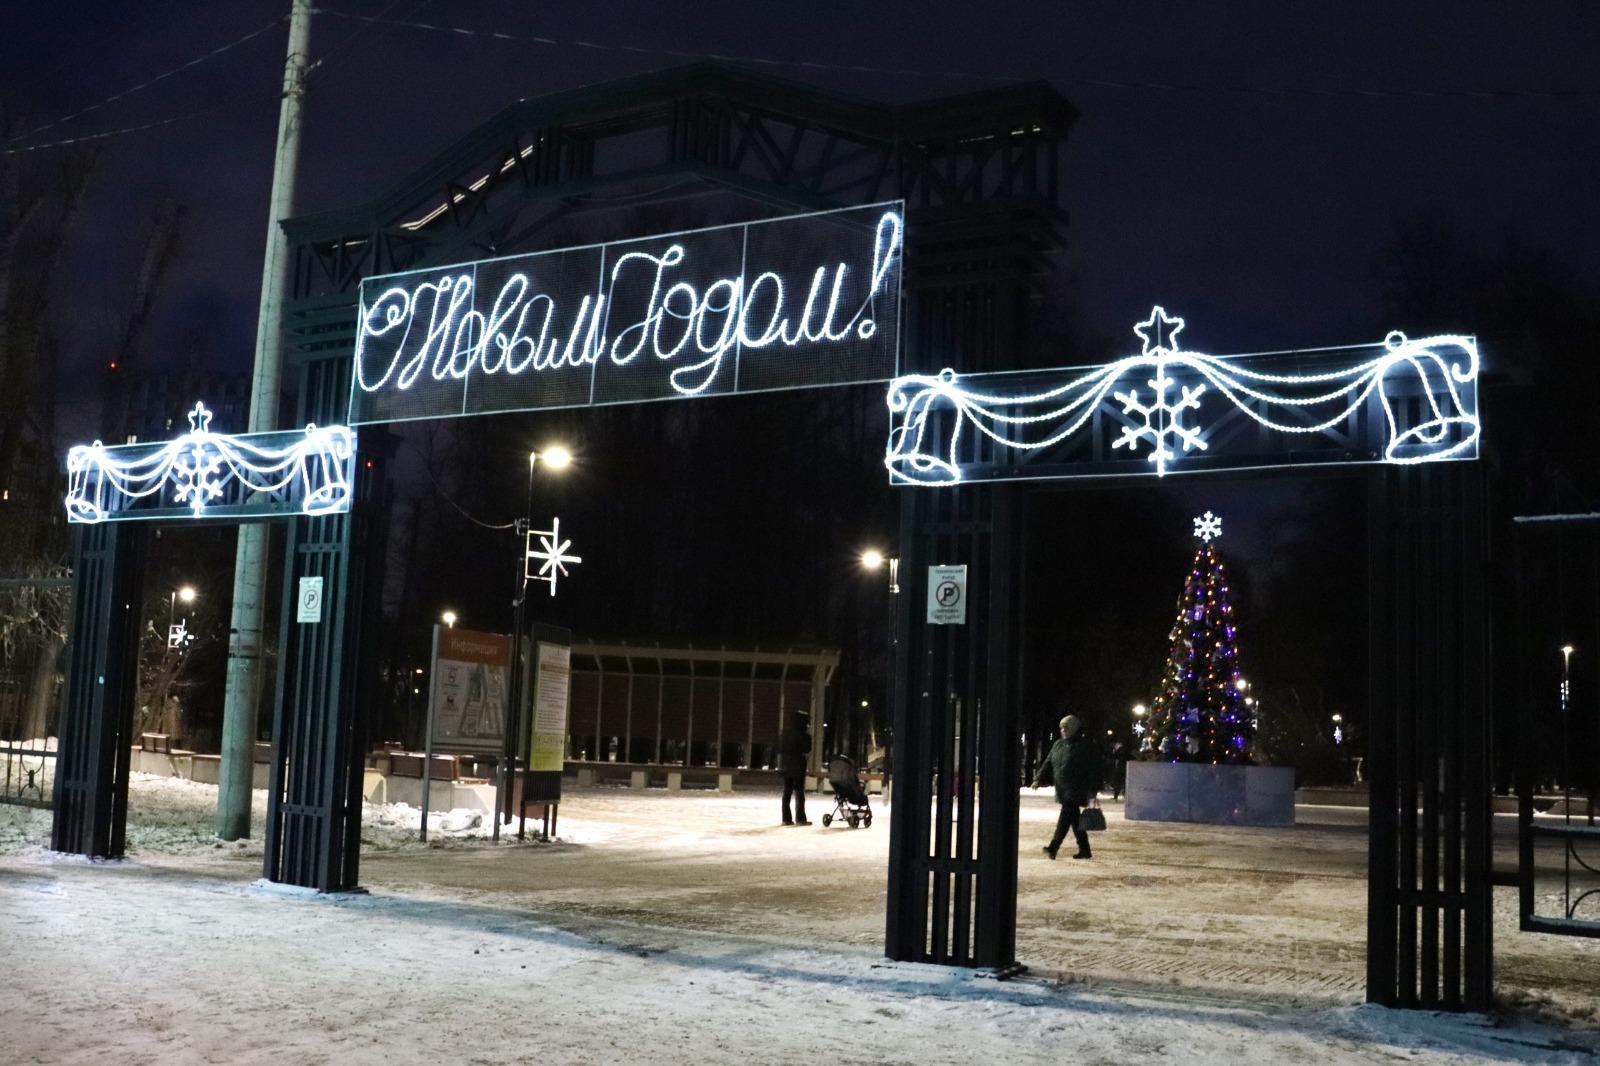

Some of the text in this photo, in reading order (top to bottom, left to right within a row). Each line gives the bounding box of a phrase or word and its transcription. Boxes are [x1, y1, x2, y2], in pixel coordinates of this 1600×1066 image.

[356, 211, 900, 395] С Новым Годом!
[450, 637, 498, 656] Информация
